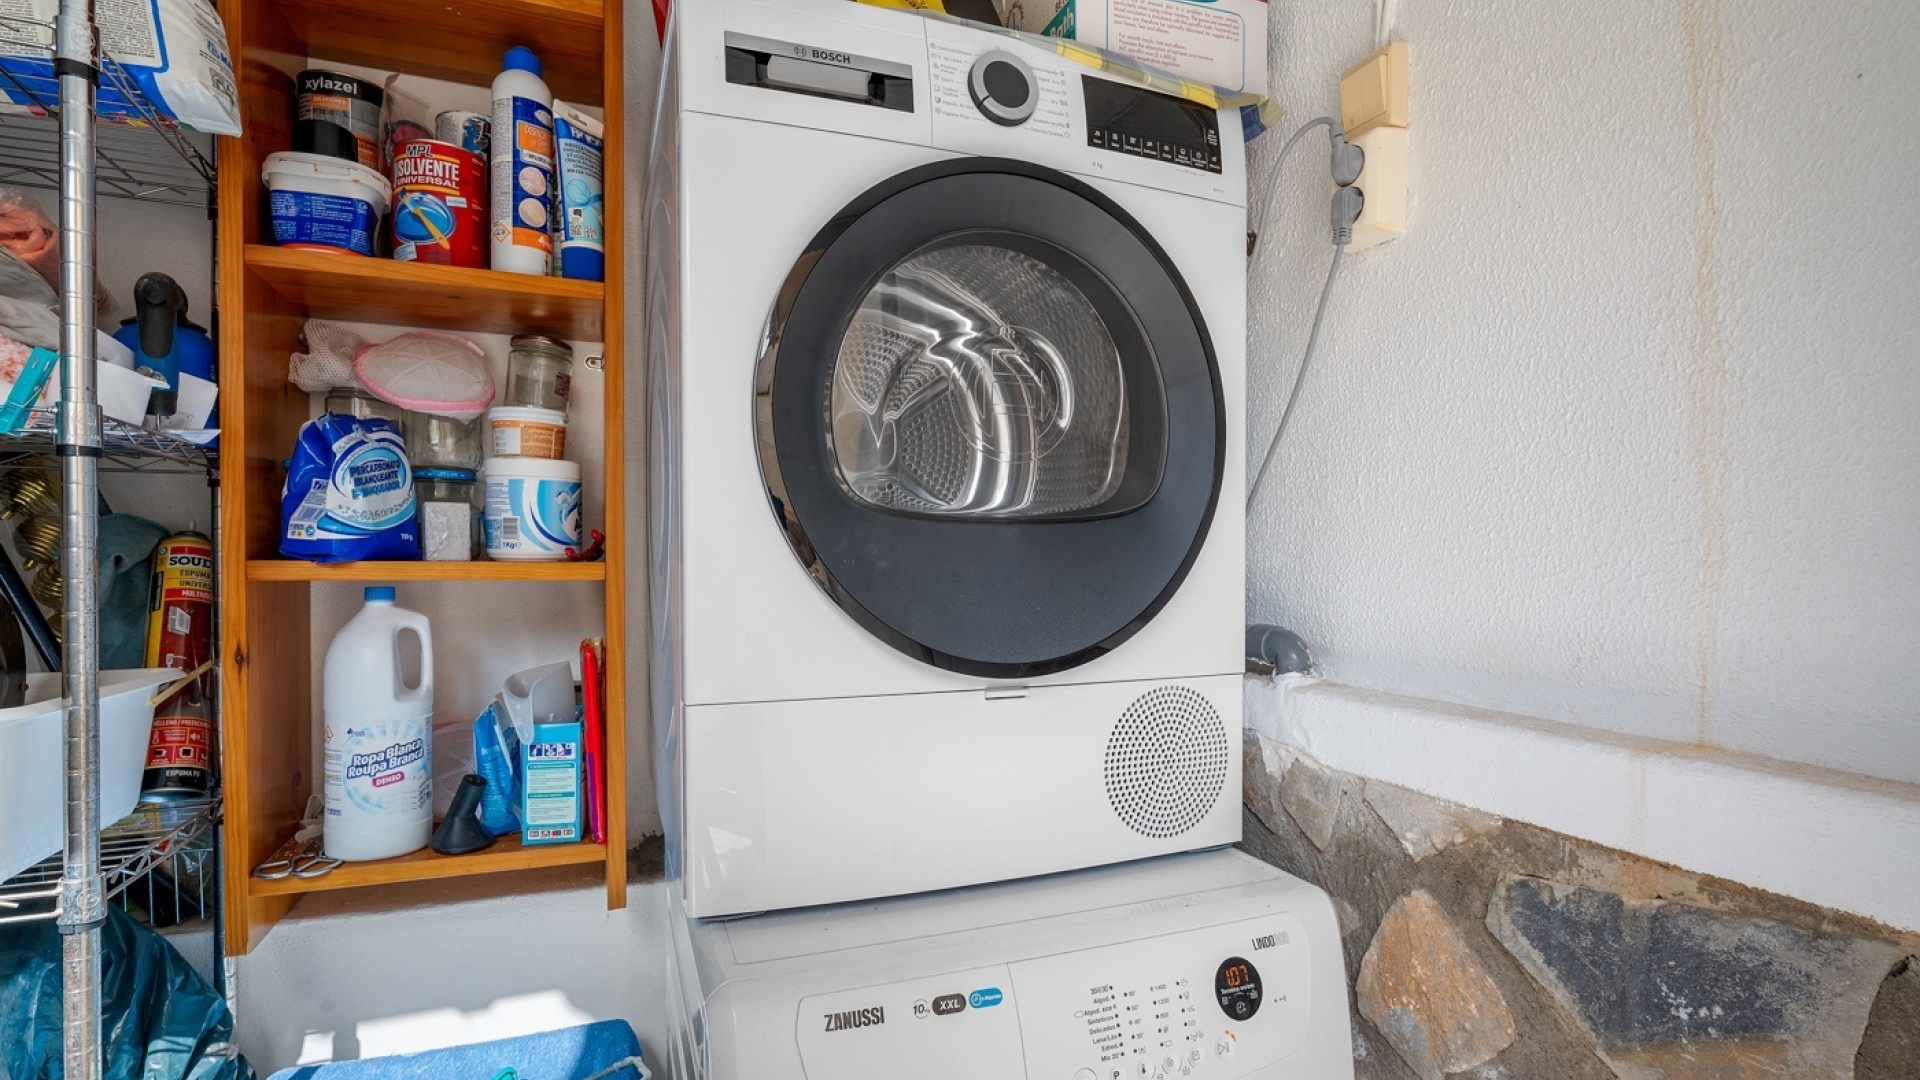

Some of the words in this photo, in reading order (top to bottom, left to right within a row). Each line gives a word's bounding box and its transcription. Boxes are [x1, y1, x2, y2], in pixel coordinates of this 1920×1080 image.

[812, 49, 851, 64] BOSCH
[305, 76, 358, 95] xylazel
[406, 144, 434, 158] MPL
[352, 751, 385, 767] Ropa
[386, 739, 423, 758] Blanca
[347, 761, 387, 779] Roupa
[388, 748, 424, 768] Branca
[939, 998, 961, 1011] XXL
[824, 1006, 885, 1032] ZANUSSI
